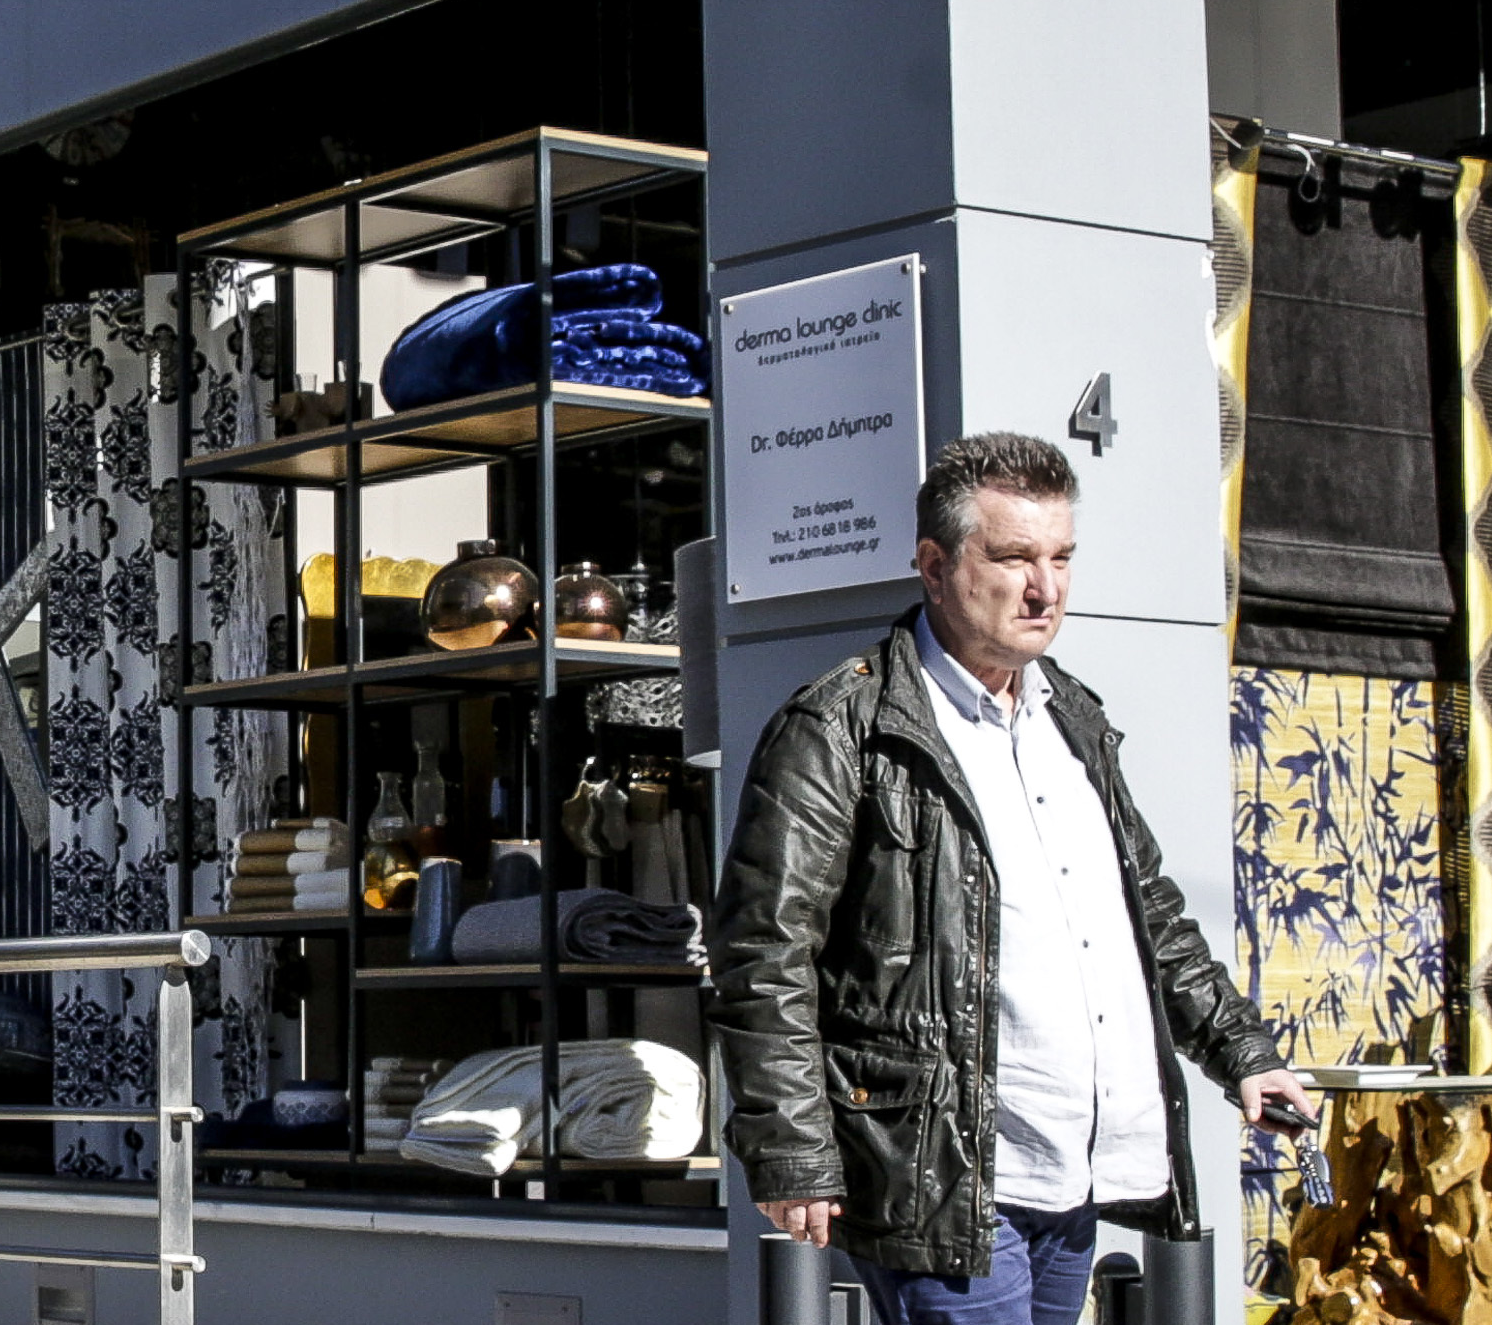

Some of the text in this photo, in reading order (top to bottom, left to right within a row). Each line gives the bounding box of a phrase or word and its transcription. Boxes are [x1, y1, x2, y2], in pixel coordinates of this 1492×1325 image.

[796, 316, 858, 340] lounge
[862, 298, 903, 324] clinic
[1072, 370, 1118, 449] 4
[751, 412, 893, 454] Dr. Φέρρα Δήμητρα
